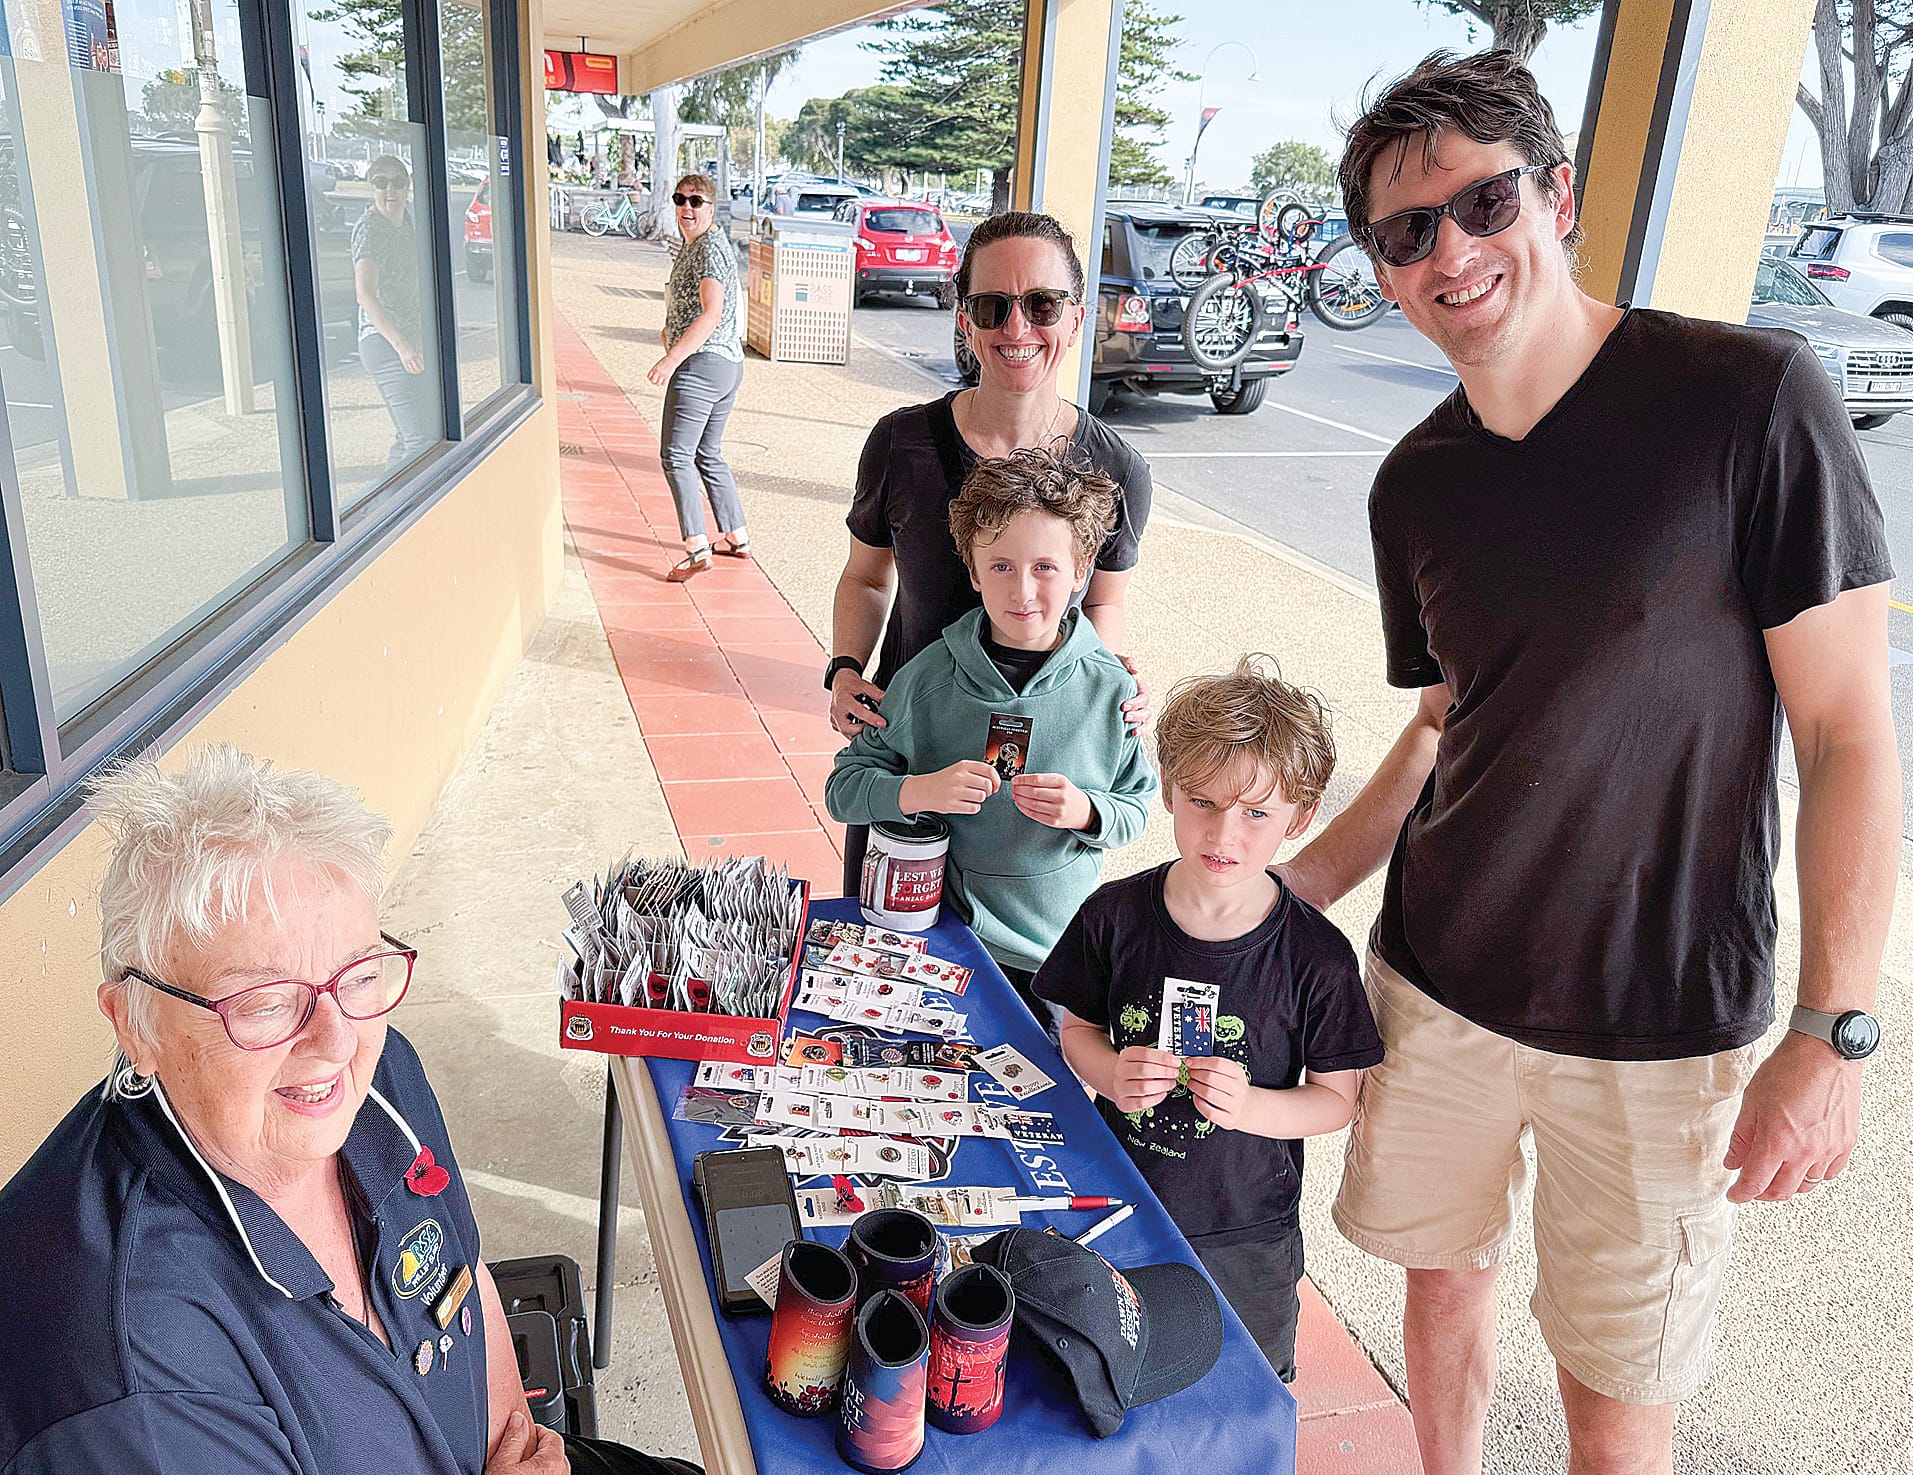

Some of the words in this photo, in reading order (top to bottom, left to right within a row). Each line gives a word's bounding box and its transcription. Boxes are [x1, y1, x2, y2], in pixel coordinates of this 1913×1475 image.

[896, 871, 927, 882] LEST
[929, 866, 943, 879] WE
[610, 1026, 637, 1036] Thank
[639, 1028, 656, 1038] You
[657, 1030, 672, 1039] For
[674, 1031, 693, 1041] Your
[695, 1034, 735, 1045] Donation
[1172, 1006, 1183, 1056] VETERAN
[1013, 1129, 1064, 1141] VETERAN
[1126, 1133, 1147, 1147] New
[1149, 1142, 1187, 1159] Zealand
[420, 1262, 448, 1306] Volunteer
[1117, 1294, 1127, 1339] DAWN
